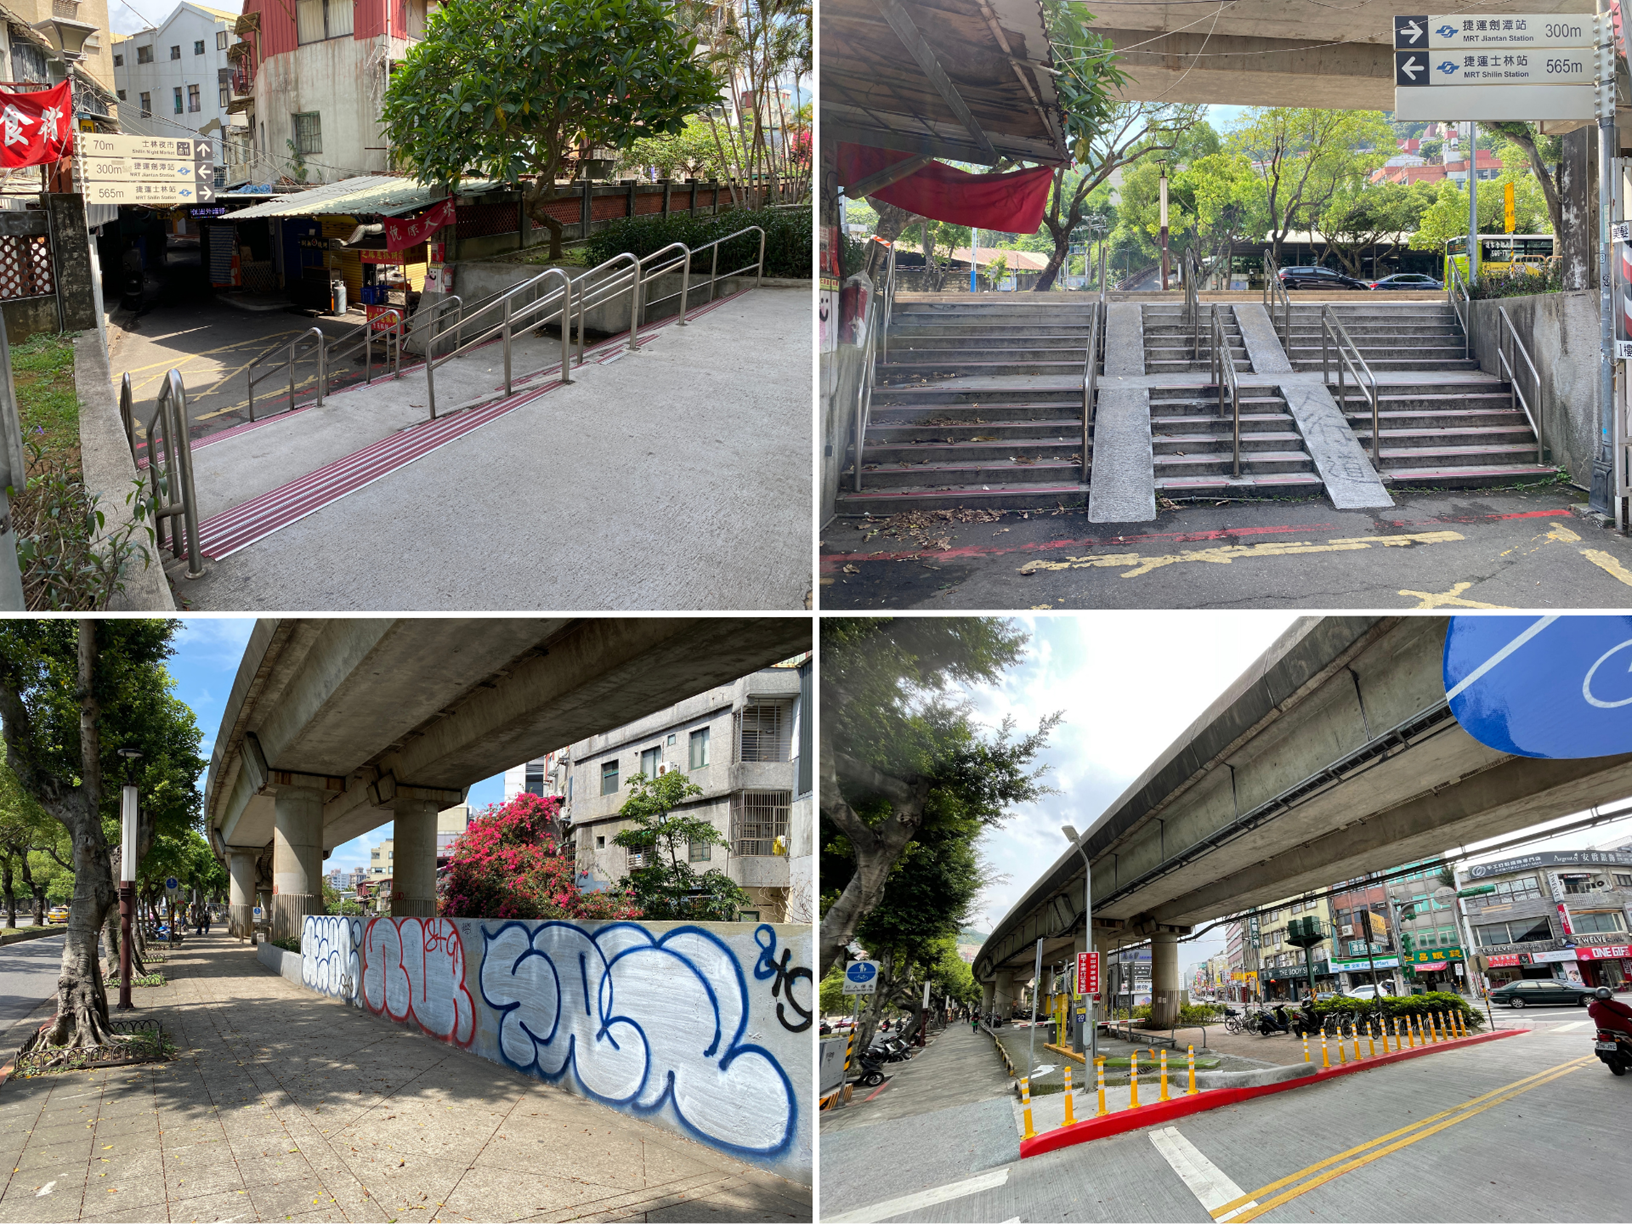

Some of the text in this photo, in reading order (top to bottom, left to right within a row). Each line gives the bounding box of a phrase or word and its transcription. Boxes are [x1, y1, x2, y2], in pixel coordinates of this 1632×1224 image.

[1463, 19, 1582, 38] 捷運劍潭站 300m
[1463, 55, 1583, 73] 捷運士林站 565m
[93, 140, 175, 151] 70m 士林夜市
[96, 162, 175, 175] 300m 捷運劍潭站
[98, 186, 176, 198] 565m 捷運士林站
[1591, 947, 1612, 958] ONE
